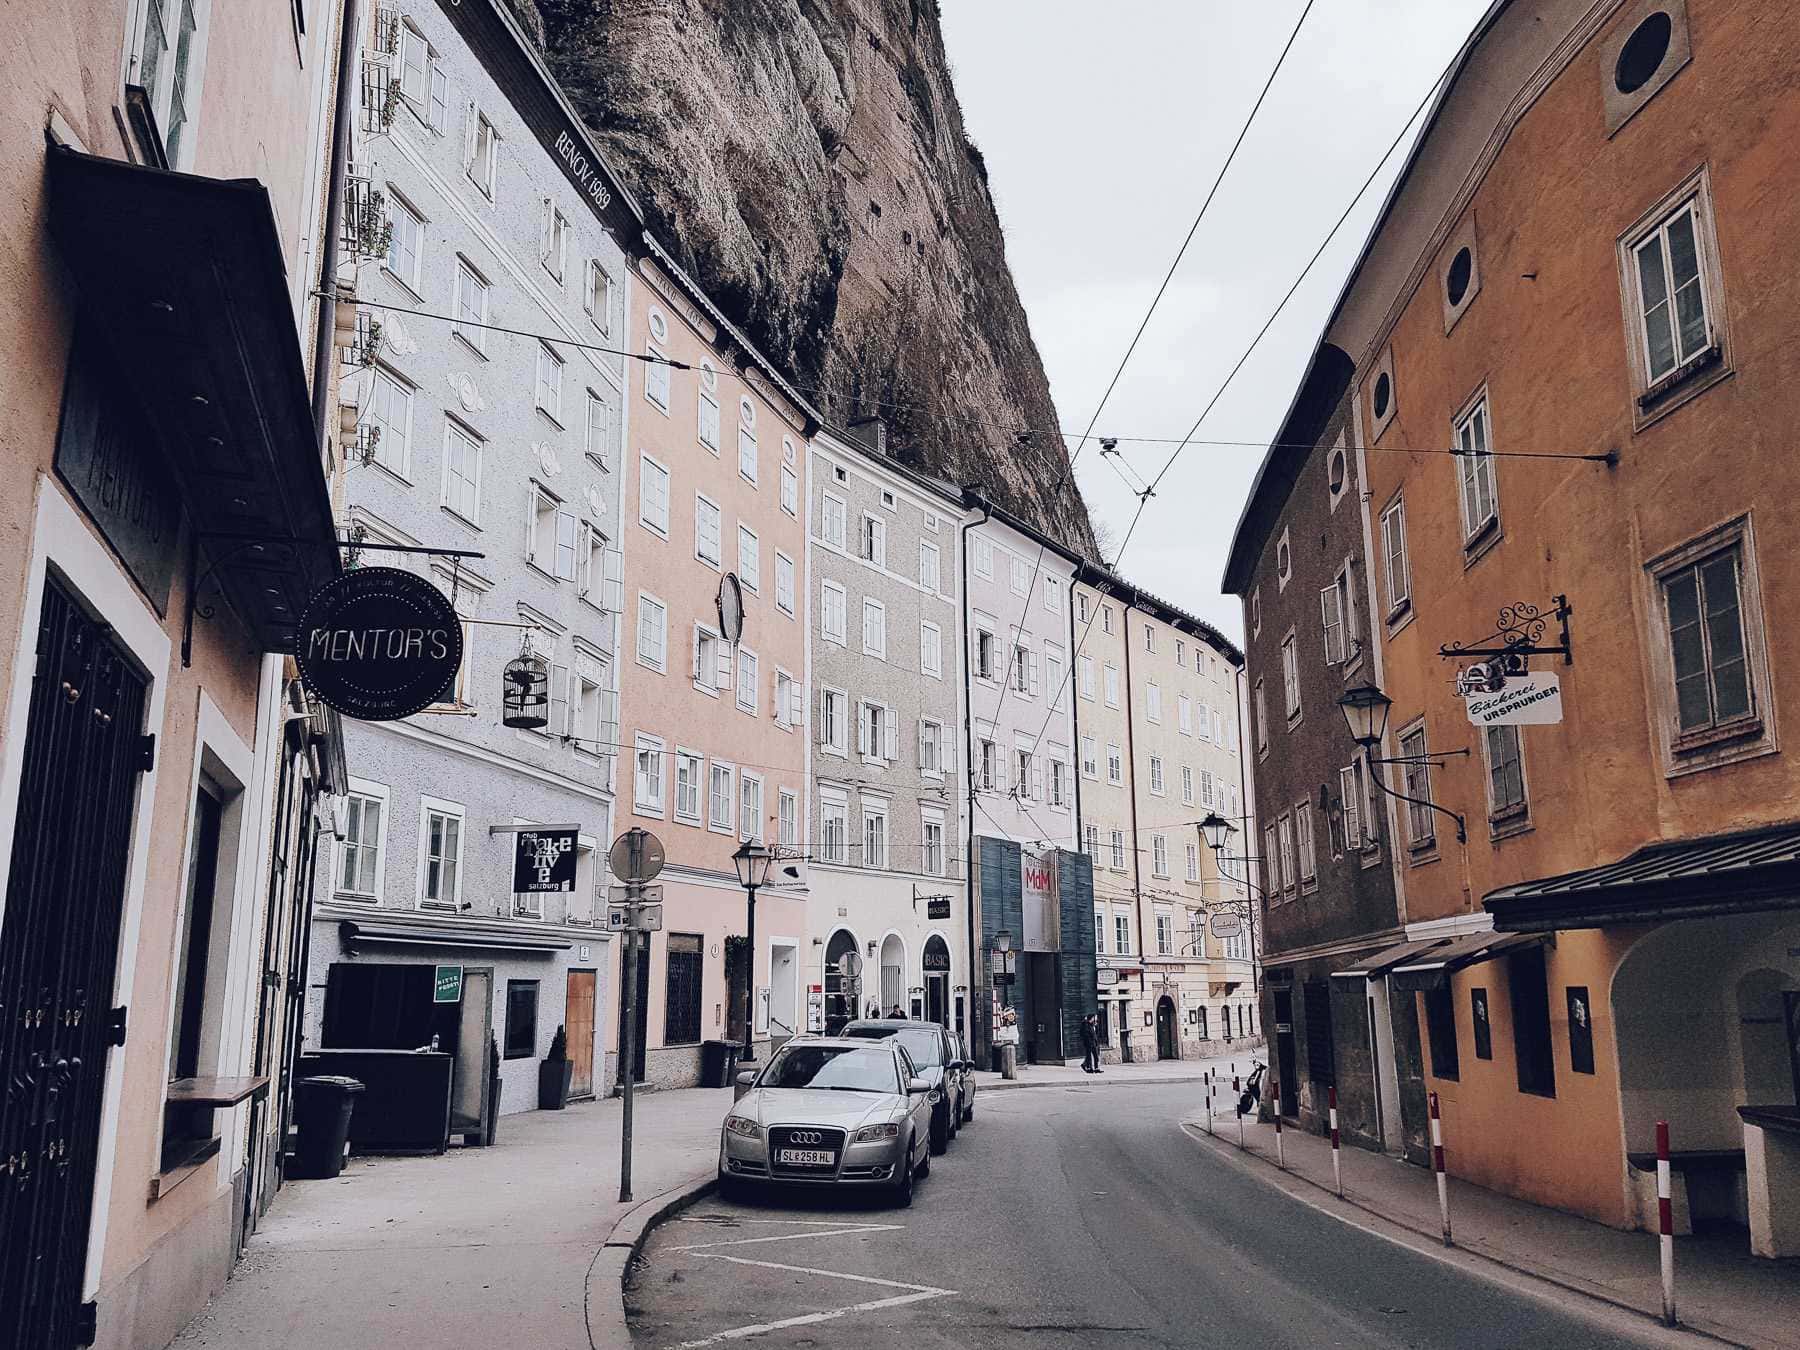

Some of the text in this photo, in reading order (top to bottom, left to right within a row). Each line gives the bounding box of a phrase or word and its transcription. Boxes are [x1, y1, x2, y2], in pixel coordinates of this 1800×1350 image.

[555, 131, 611, 210] RENOV. 1989
[308, 628, 448, 661] MENTOR'S
[1468, 682, 1536, 714] Bäckerei
[1483, 685, 1559, 722] URSPRUNGER
[528, 882, 559, 891] salzburg
[1026, 867, 1051, 891] MdM
[925, 954, 948, 967] BASIC
[783, 1151, 830, 1164] SL 258 HL
